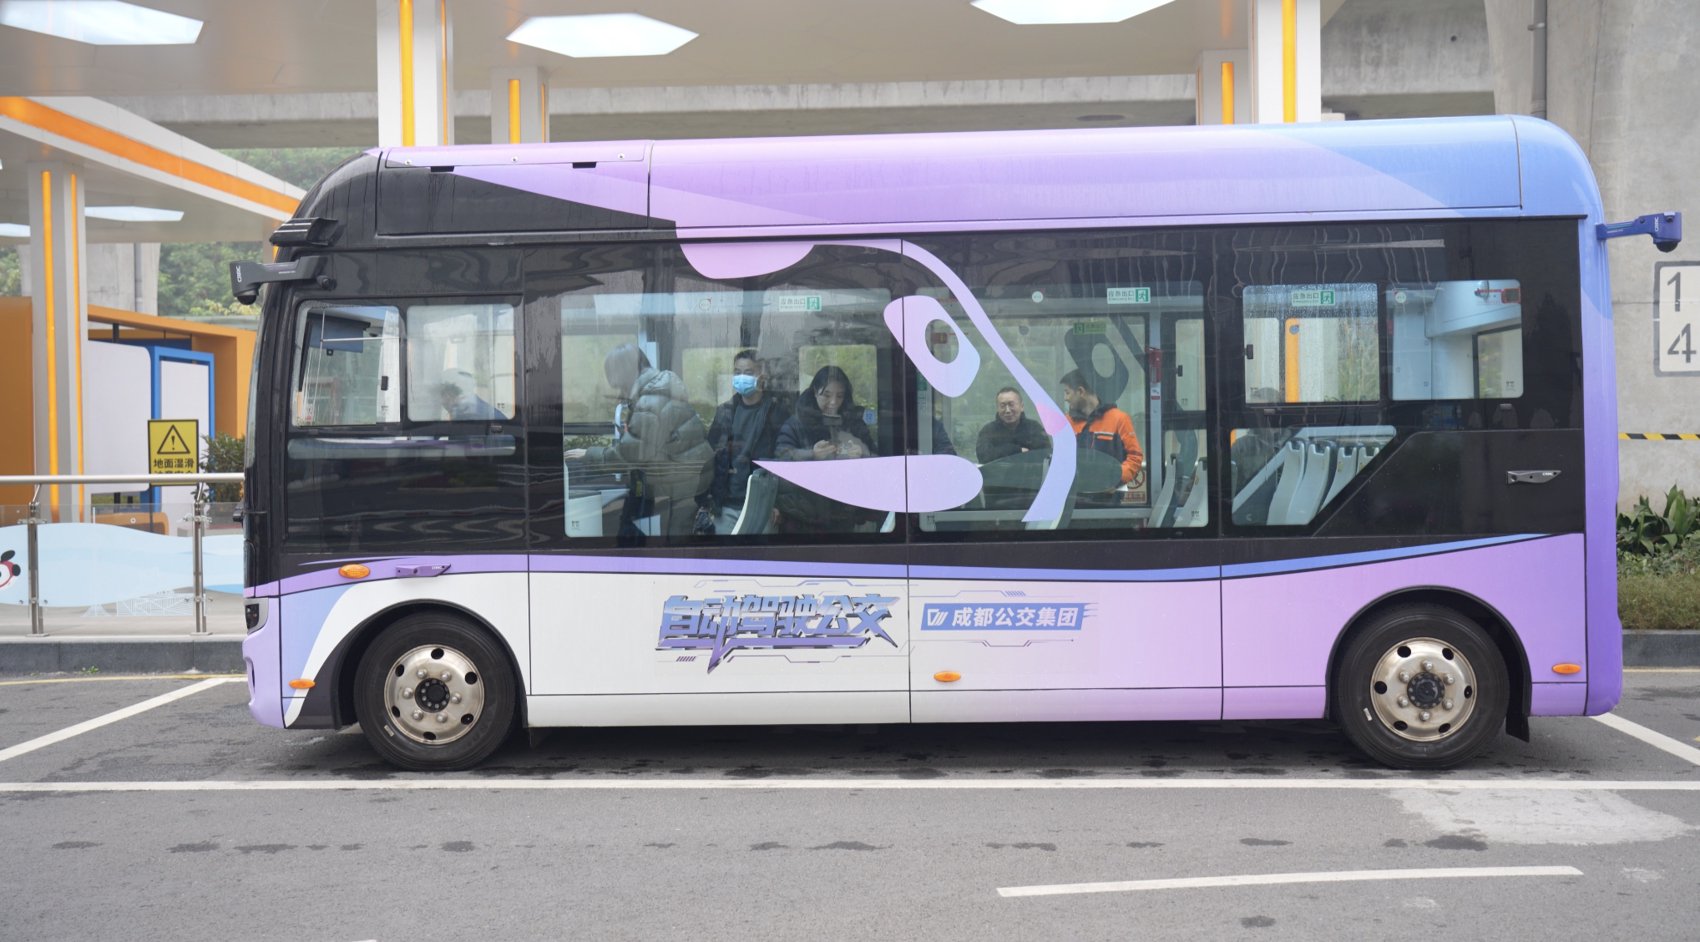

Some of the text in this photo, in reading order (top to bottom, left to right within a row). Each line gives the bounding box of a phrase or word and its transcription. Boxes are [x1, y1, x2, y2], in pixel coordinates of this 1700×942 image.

[1667, 271, 1681, 312] 1
[1667, 323, 1697, 363] 4
[656, 593, 901, 650] 自动驾驶公交
[952, 606, 1079, 628] 成都公交集团
